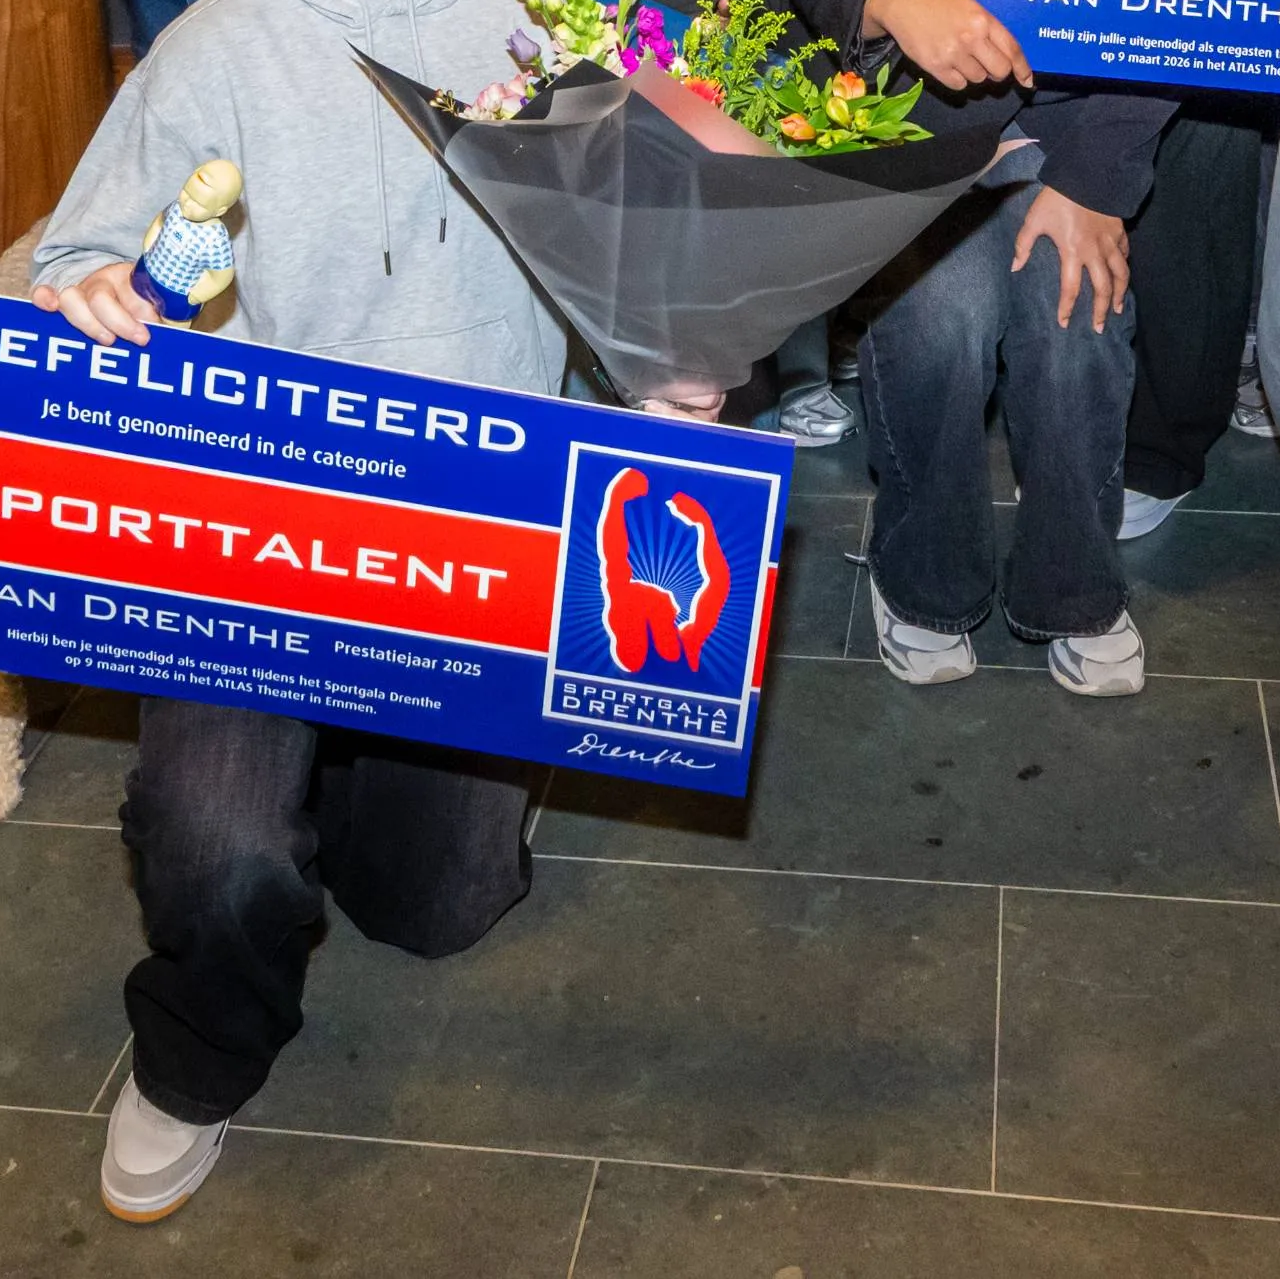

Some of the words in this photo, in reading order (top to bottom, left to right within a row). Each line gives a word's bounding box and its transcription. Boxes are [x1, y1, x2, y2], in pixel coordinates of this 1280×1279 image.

[1039, 27, 1075, 43] Hierbij
[1077, 31, 1097, 44] zijn
[1098, 32, 1127, 45] jullie
[1129, 36, 1196, 53] uitgenodigd
[1198, 41, 1214, 53] als
[1217, 45, 1272, 58] eregasten
[1101, 51, 1115, 63] op
[1118, 51, 1125, 62] 9
[1127, 54, 1161, 65] maart
[1163, 55, 1191, 68] 2026
[1193, 60, 1204, 69] in
[1207, 58, 1225, 71] het
[1228, 61, 1261, 74] ATLAS
[41, 398, 61, 419] Je
[67, 401, 112, 427] bent
[118, 415, 251, 451] genomineerd
[257, 436, 275, 456] in
[281, 441, 307, 461] de
[313, 450, 407, 478] categorie
[85, 594, 310, 653] DRENTHE
[335, 641, 437, 669] Prestatiejaar
[443, 659, 481, 676] 2025
[7, 629, 49, 646] Hierbij
[53, 635, 77, 649] ben
[80, 639, 93, 652] je
[96, 644, 174, 665] uitgenodigd
[178, 657, 195, 667] als
[200, 662, 247, 676] eregast
[252, 668, 295, 684] tijdens
[299, 675, 321, 688] het
[325, 681, 385, 699] Sportgala
[389, 691, 442, 709] Drenthe
[65, 656, 82, 668] op
[85, 656, 93, 667] 9
[97, 661, 135, 674] maart
[139, 665, 170, 680] 2026
[173, 670, 185, 682] in
[190, 673, 211, 685] het
[215, 678, 253, 692] ATLAS
[258, 685, 306, 701] Theater
[309, 695, 321, 705] in
[325, 696, 377, 714] Emmen.
[562, 696, 728, 734] DRENTHE
[563, 683, 728, 720] SPORTGALA
[567, 733, 716, 769] Drenthe
